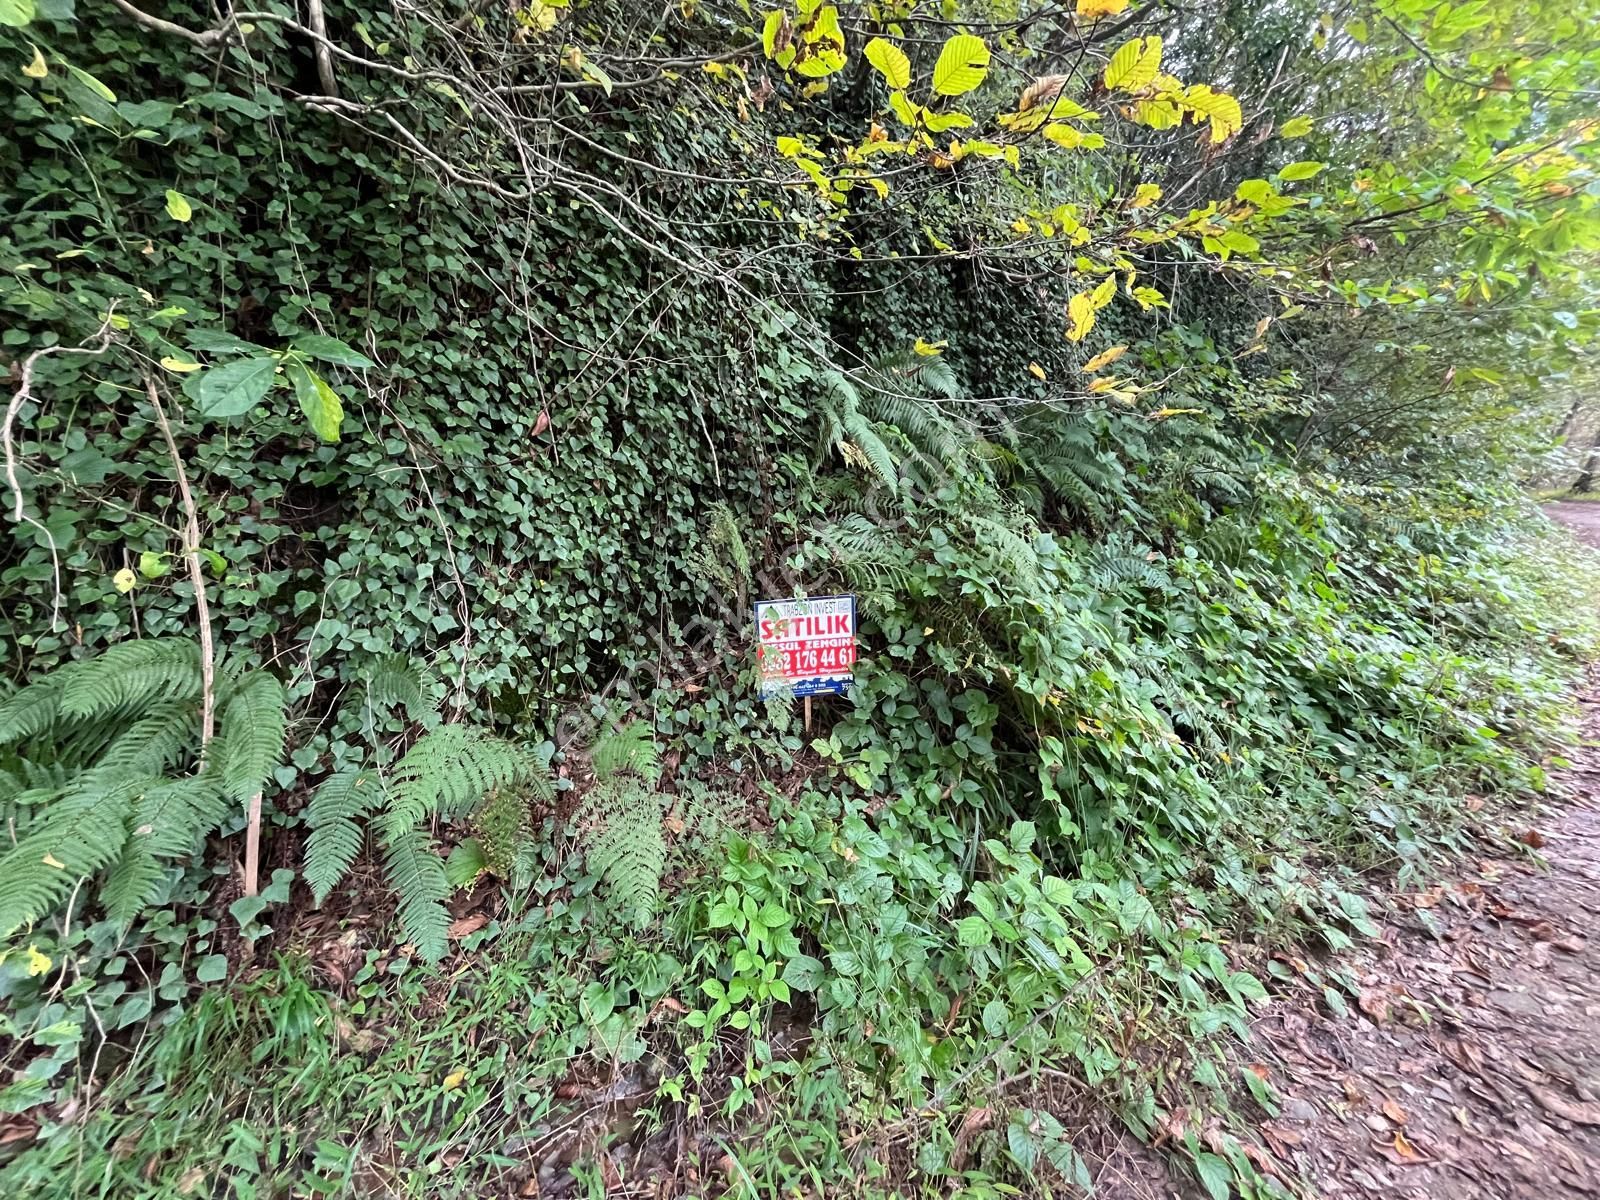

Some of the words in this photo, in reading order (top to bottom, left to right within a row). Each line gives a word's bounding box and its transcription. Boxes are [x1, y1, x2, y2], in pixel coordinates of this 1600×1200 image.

[783, 603, 813, 617] TRABZN
[815, 601, 836, 615] INVEST
[761, 615, 850, 640] SATILIK
[765, 641, 801, 652] ESUL
[796, 650, 817, 669] 176
[821, 649, 836, 667] 44
[839, 647, 852, 665] 61
